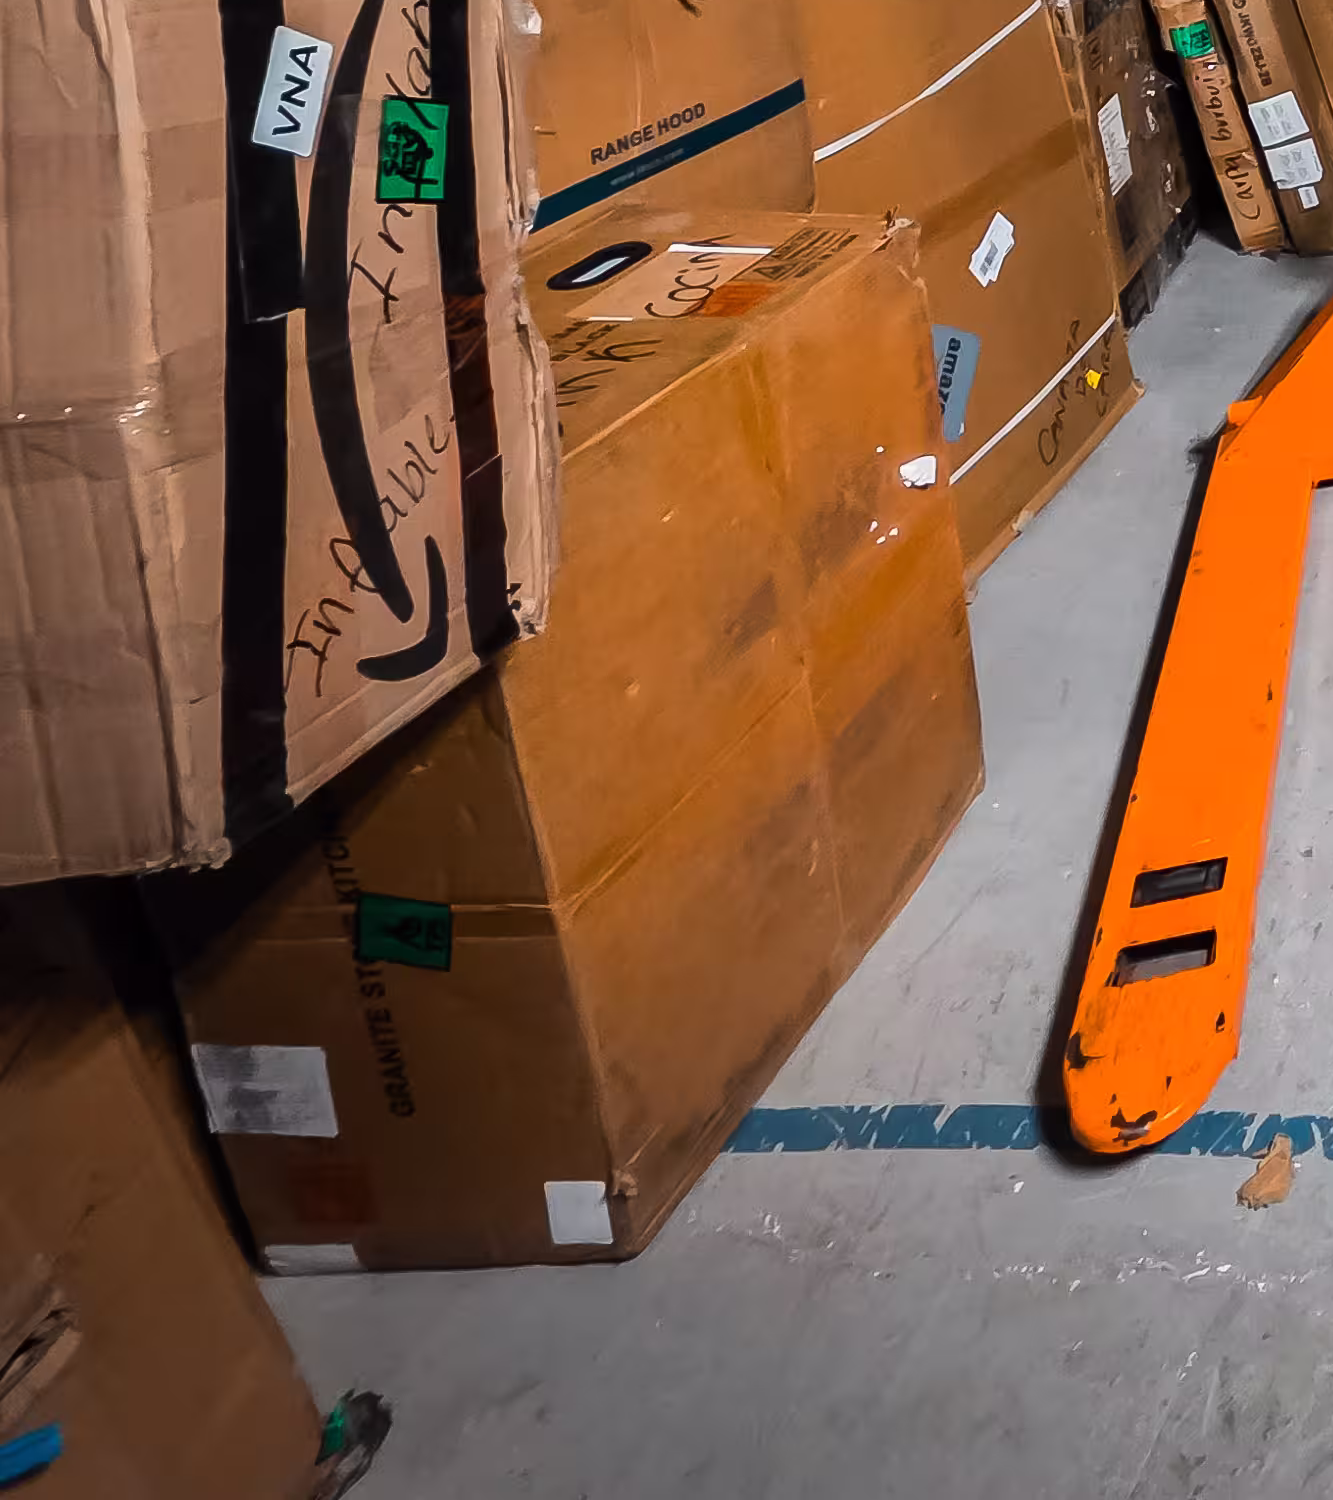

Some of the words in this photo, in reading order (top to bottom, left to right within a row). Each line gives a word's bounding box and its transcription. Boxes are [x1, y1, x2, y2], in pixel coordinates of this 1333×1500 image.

[271, 45, 319, 136] VNA
[590, 125, 655, 166] RANGE
[657, 101, 707, 137] HOOD
[365, 1007, 416, 1119] GRANITE
